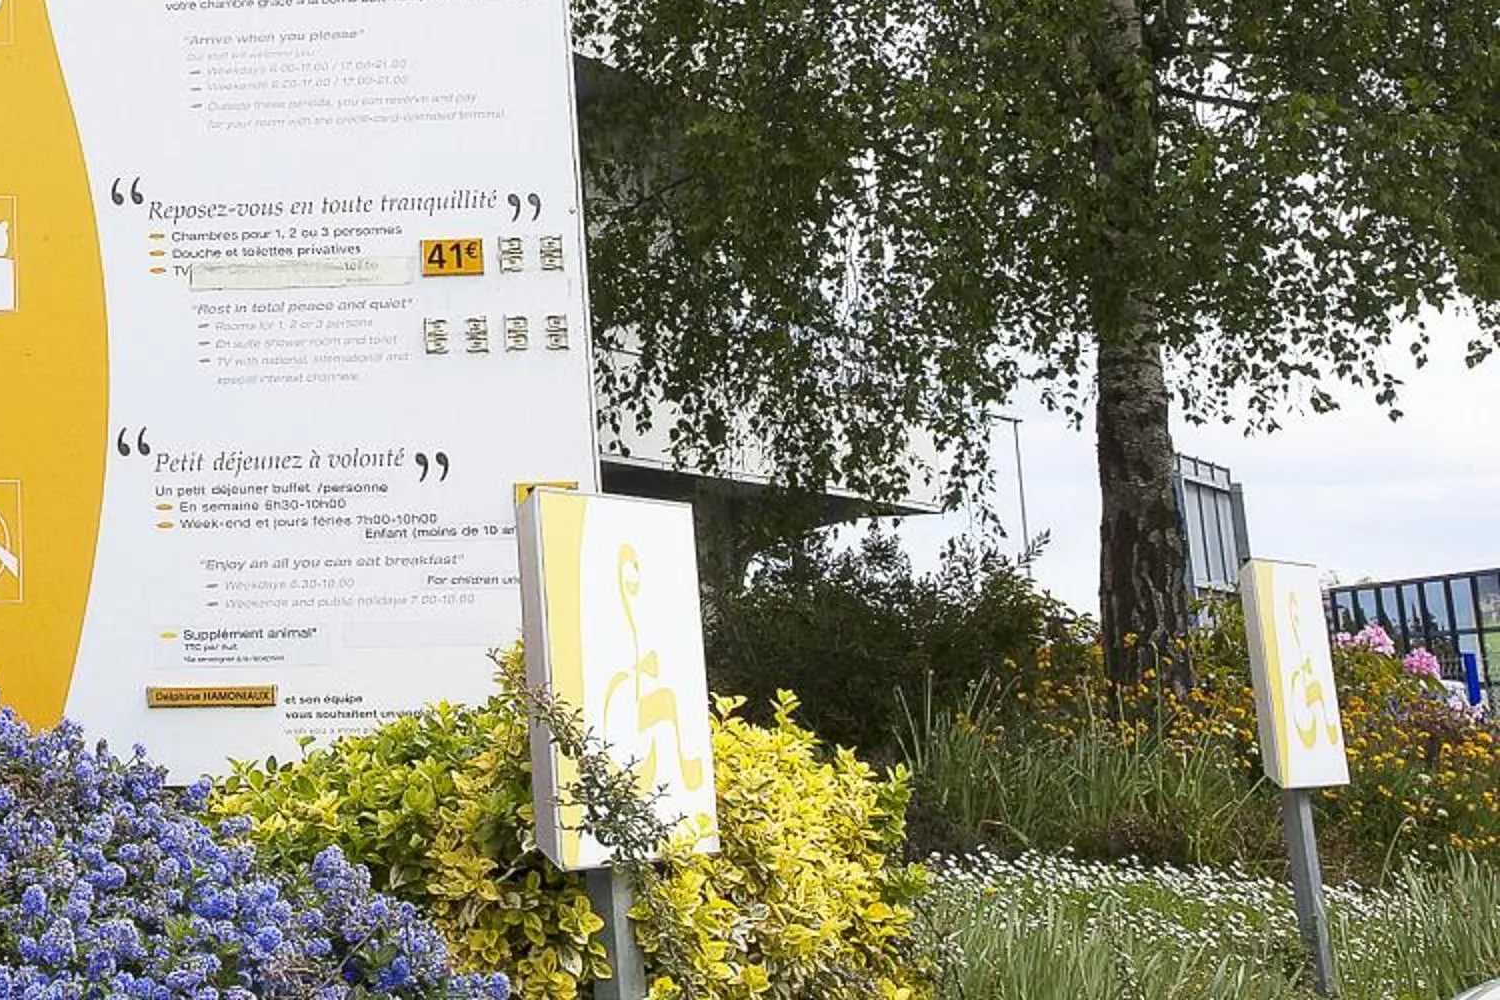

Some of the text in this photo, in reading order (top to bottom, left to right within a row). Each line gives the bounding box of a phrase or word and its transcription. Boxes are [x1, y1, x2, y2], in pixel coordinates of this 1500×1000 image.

[148, 188, 498, 225] Reposez-vous en toute tranquillité
[171, 230, 239, 243] Chambres
[241, 231, 272, 242] pour
[289, 227, 297, 238] 2
[301, 228, 318, 239] ou
[321, 226, 330, 237] 3
[333, 224, 403, 240] personnes
[171, 242, 361, 260] Douche et toilettes privatives
[426, 241, 479, 270] 41€
[172, 265, 190, 277] TV
[251, 300, 286, 313] total
[287, 300, 335, 313] peace
[337, 299, 367, 311] and
[154, 447, 405, 478] Petit déjeunez à volonté
[154, 485, 174, 497] Un
[177, 485, 206, 498] petit
[272, 482, 311, 494] buffet
[179, 500, 198, 513] En
[201, 501, 260, 513] semaine
[179, 517, 252, 530] Week-end
[255, 517, 270, 529] et
[365, 526, 408, 539] Enfant
[412, 525, 458, 540] (moins
[461, 524, 479, 536] de
[249, 558, 269, 569] an
[291, 557, 321, 571] you
[324, 556, 352, 568] can
[426, 575, 449, 585] For
[451, 573, 499, 585] children
[182, 628, 264, 643] Supplément
[284, 694, 297, 705] et
[299, 694, 322, 705] son
[285, 709, 314, 719] vous
[315, 708, 378, 719] souhaitent
